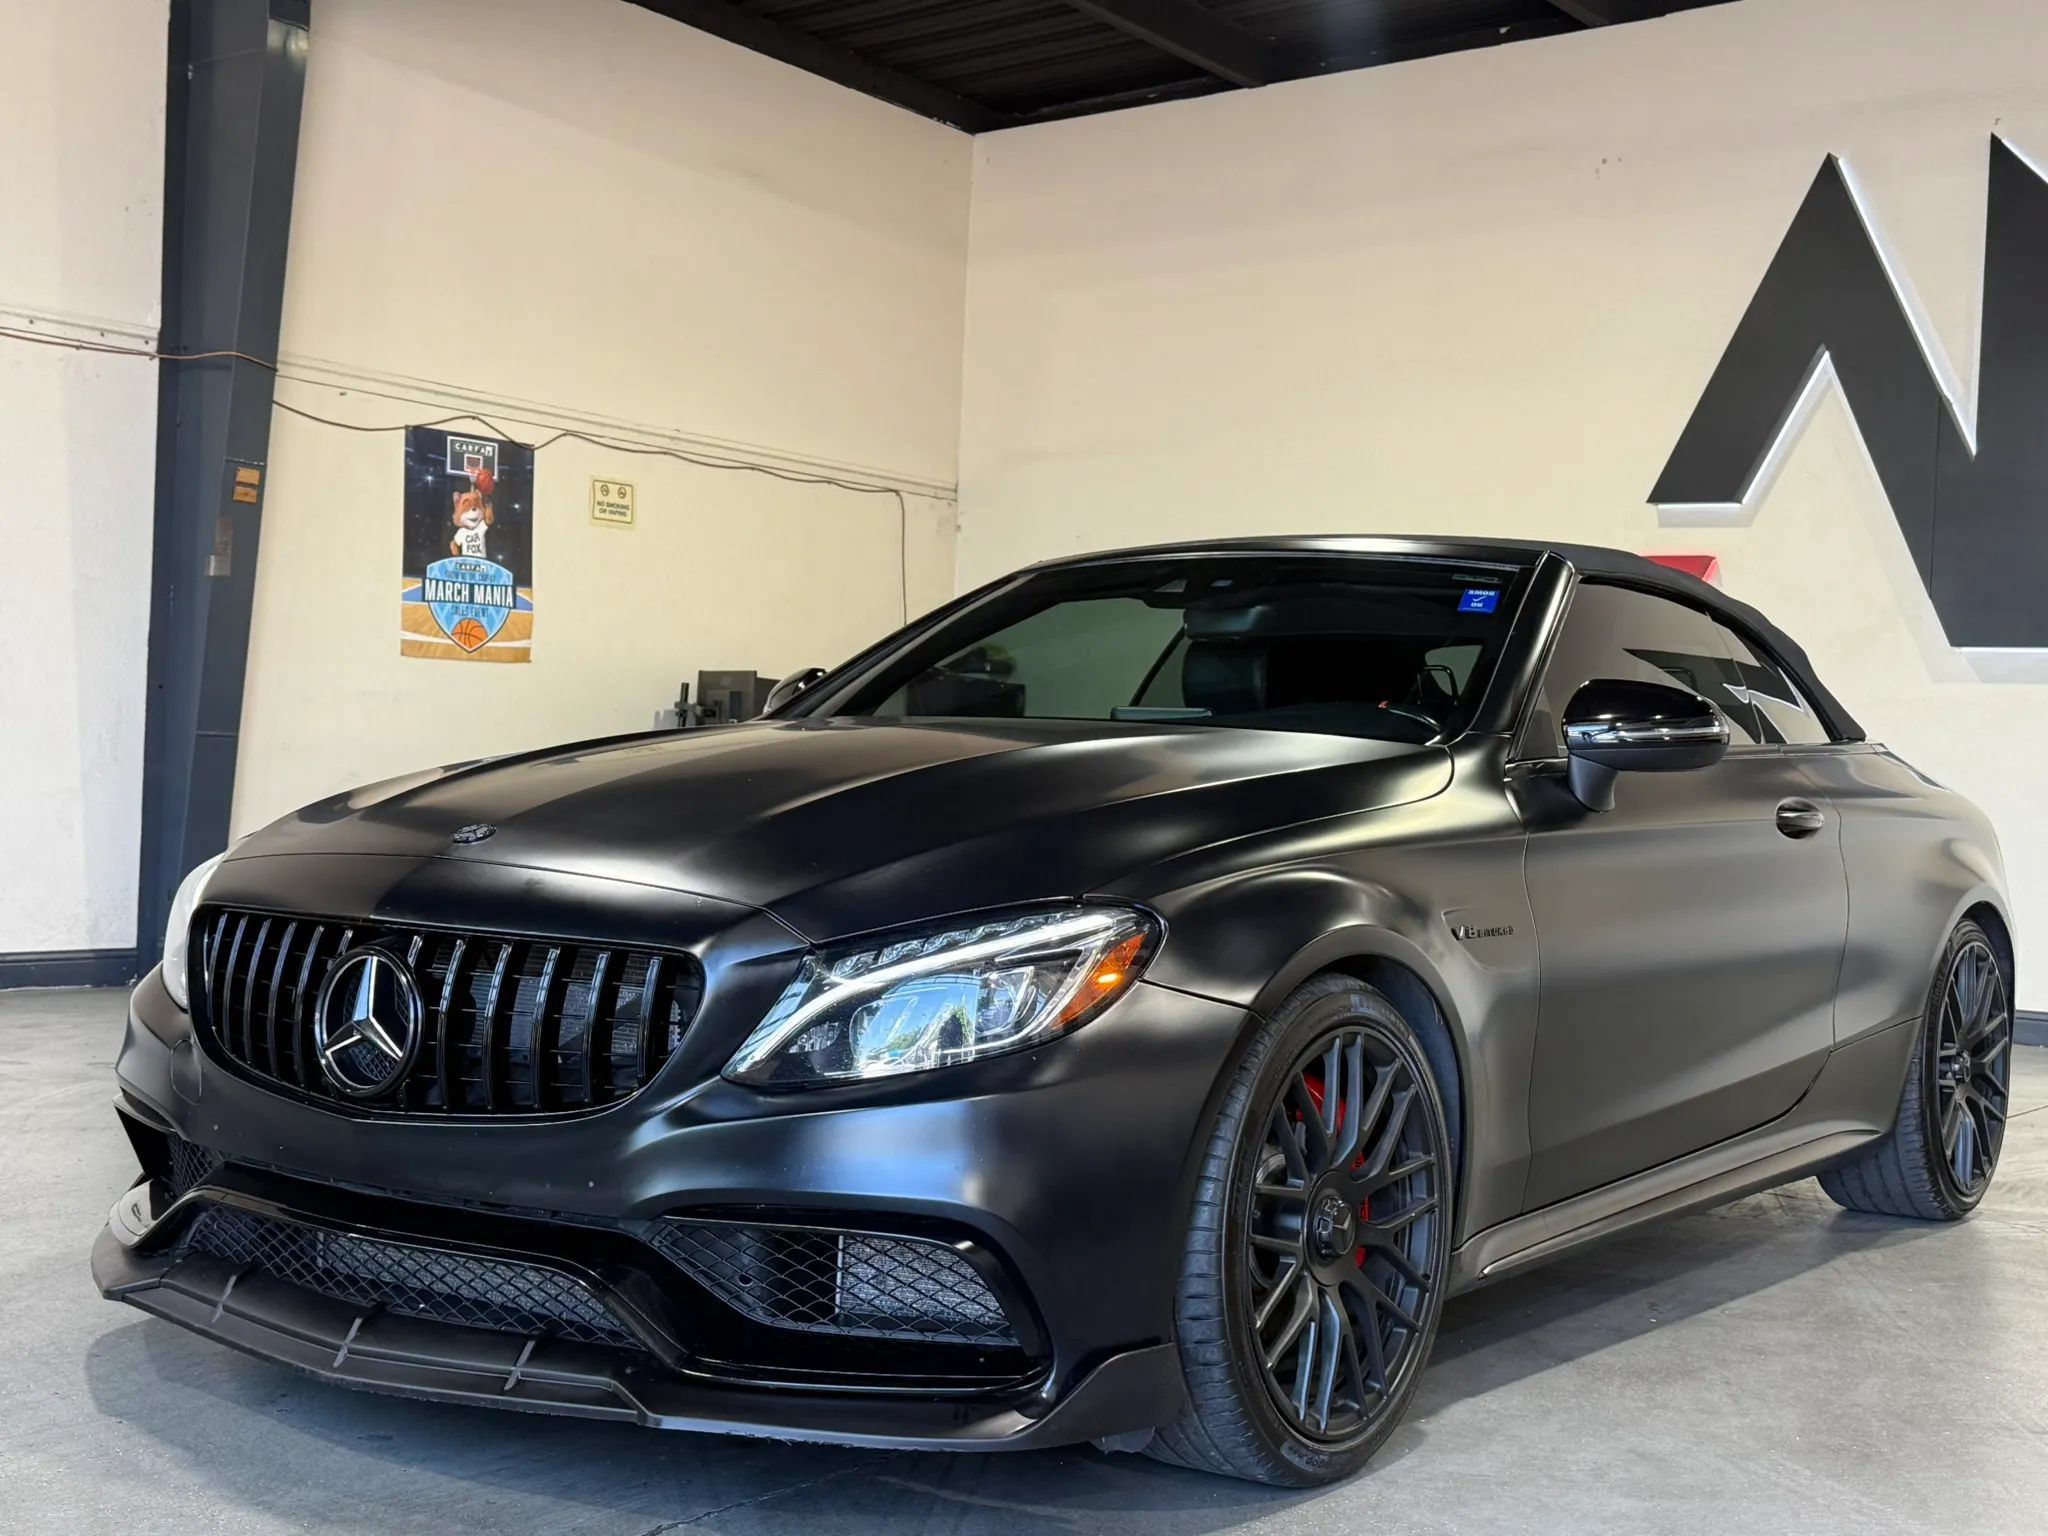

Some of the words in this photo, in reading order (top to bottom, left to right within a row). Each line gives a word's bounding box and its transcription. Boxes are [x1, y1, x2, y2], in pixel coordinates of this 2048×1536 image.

[606, 501, 630, 511] SMOKING
[465, 533, 480, 544] CAR
[466, 544, 481, 554] FOX
[425, 578, 469, 603] MARCH
[474, 584, 513, 608] MANIA
